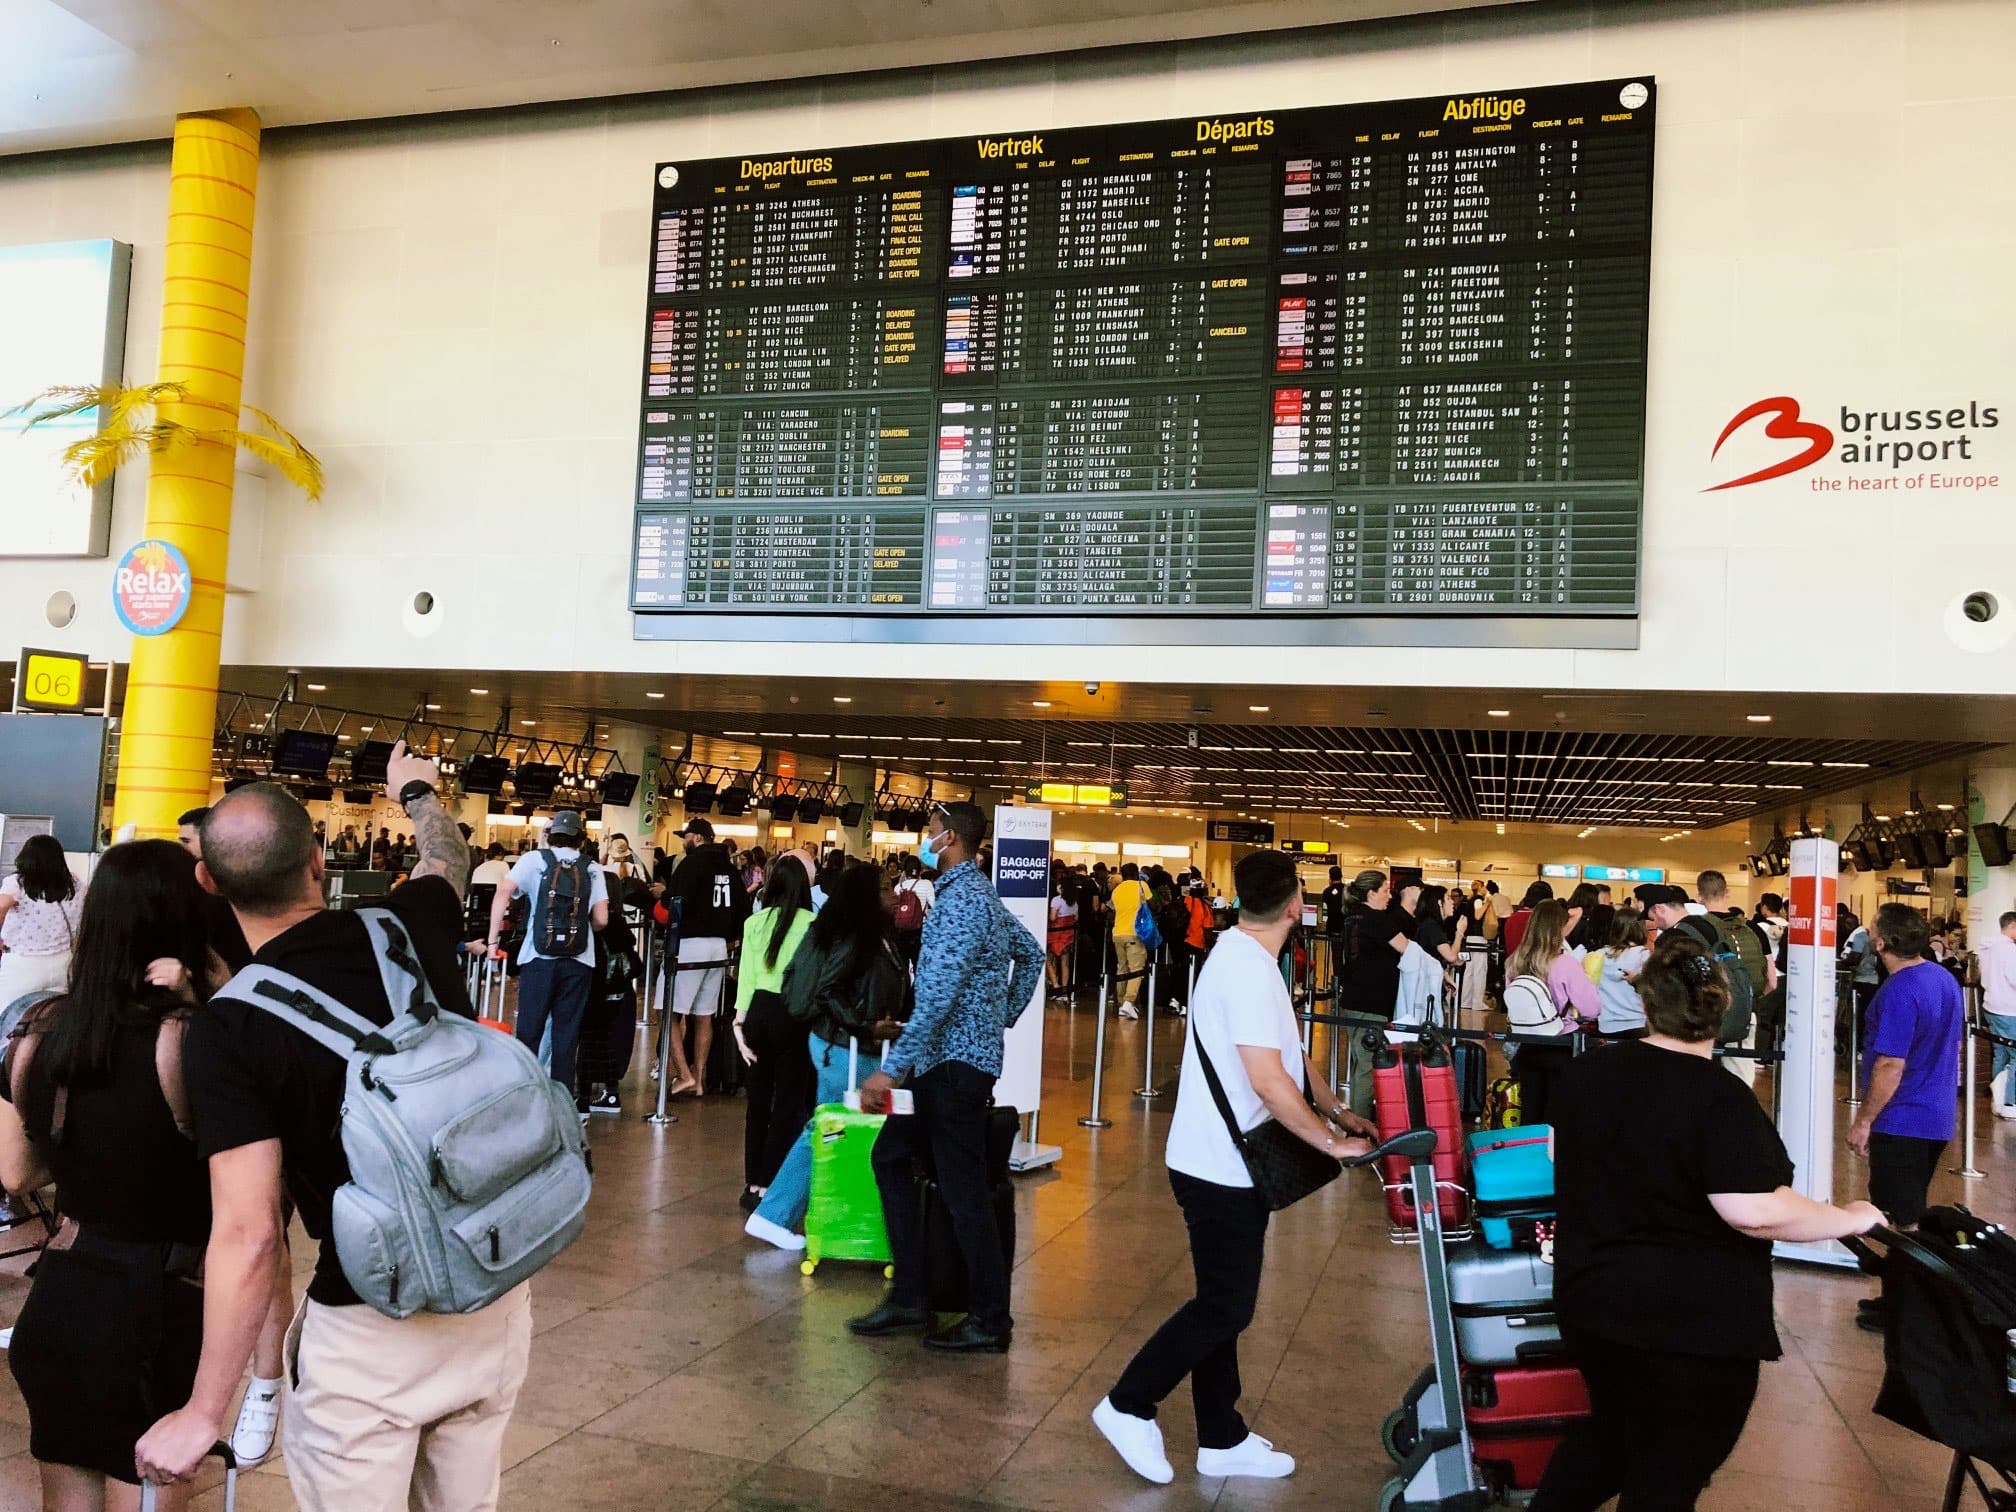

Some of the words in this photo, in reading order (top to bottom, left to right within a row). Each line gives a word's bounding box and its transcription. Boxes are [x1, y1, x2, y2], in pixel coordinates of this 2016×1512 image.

[1443, 96, 1525, 120] Abflüge
[1473, 124, 1511, 132] DESTINATION
[1601, 113, 1632, 121] REMARKS
[1197, 116, 1273, 143] Départs
[977, 135, 1042, 158] Vertrek
[1455, 146, 1515, 157] WASHINGTON
[740, 156, 832, 180] Departures
[1454, 159, 1496, 170] ANTALYA
[1103, 173, 1151, 183] HERAKLION
[1455, 173, 1477, 182] LOME
[1102, 186, 1134, 195] MADRID
[1424, 188, 1446, 196] VIA:
[1454, 185, 1483, 194] ACCRA
[792, 198, 820, 207] ATHENS
[892, 191, 921, 199] BOARDING
[1102, 196, 1149, 207] MARSEILLE
[791, 208, 833, 218] BUCHAREST
[1102, 210, 1122, 218] OSLO
[1453, 210, 1488, 219] BANJUL
[791, 221, 818, 229] BERLIN
[1101, 221, 1138, 230] CHICAGO
[1423, 225, 1445, 233] VIA:
[1453, 222, 1482, 231] DAKAR
[790, 230, 832, 240] FRANKFURT
[1101, 233, 1126, 242] PORTO
[1452, 235, 1482, 243] MILAN
[1489, 233, 1506, 241] MXP
[1121, 243, 1146, 252] DHABI
[789, 253, 826, 262] ALICANTE
[788, 264, 835, 273] COPENHAGEN
[1451, 265, 1498, 274] MONROVIA
[1421, 280, 1443, 288] VIA:
[1451, 277, 1499, 287] FREETOWN
[1119, 285, 1139, 293] YORK
[1450, 289, 1504, 299] REYKJAVIK
[786, 303, 828, 312] BARCELONA
[1096, 308, 1144, 318] FRANKFURT
[1450, 314, 1503, 324] BARCELONA
[1095, 333, 1127, 342] LONDON
[1133, 332, 1148, 340] LHR
[1210, 327, 1246, 336] CANCELLED
[1450, 328, 1479, 337] TUNIS
[1448, 339, 1502, 349] ESKISEHIR
[1095, 356, 1136, 365] ISTANBUL
[1446, 383, 1501, 392] MARRAKECH
[1092, 398, 1129, 406] ABIDJAN
[1447, 397, 1476, 405] OUJDA
[1092, 410, 1128, 418] COTONOU
[1448, 409, 1494, 418] ISTANBUL
[1502, 408, 1519, 416] SAW
[1840, 400, 1999, 432] brussels
[1091, 422, 1122, 430] BEIRUT
[1446, 421, 1494, 430] TENERIFE
[1089, 446, 1130, 454] HELSINKI
[1445, 447, 1480, 455] MUNICH
[1840, 434, 1972, 468] airport
[1444, 459, 1499, 468] MARRAKECH
[1444, 472, 1480, 480] AGADIR
[1088, 482, 1119, 490] LISBON
[1812, 476, 1841, 491] the
[1848, 475, 1899, 490] heart
[1905, 474, 1925, 488] of
[1930, 473, 1999, 490] Europe
[1443, 503, 1515, 512] FUERTEVENTUR
[1442, 516, 1496, 524] LANZAROTE
[1472, 528, 1515, 537] CANARIA
[1441, 541, 1489, 550] ALICANTE
[1441, 554, 1489, 562] VALENCIA
[1083, 570, 1125, 578] ALICANTE
[1471, 567, 1489, 575] FCO
[116, 566, 186, 594] Relax
[1439, 580, 1476, 588] ATHENS
[35, 673, 70, 696] 06
[1000, 856, 1046, 868] BAGGAGE
[1000, 870, 1045, 880] DROP-OFF
[713, 884, 731, 908] 01
